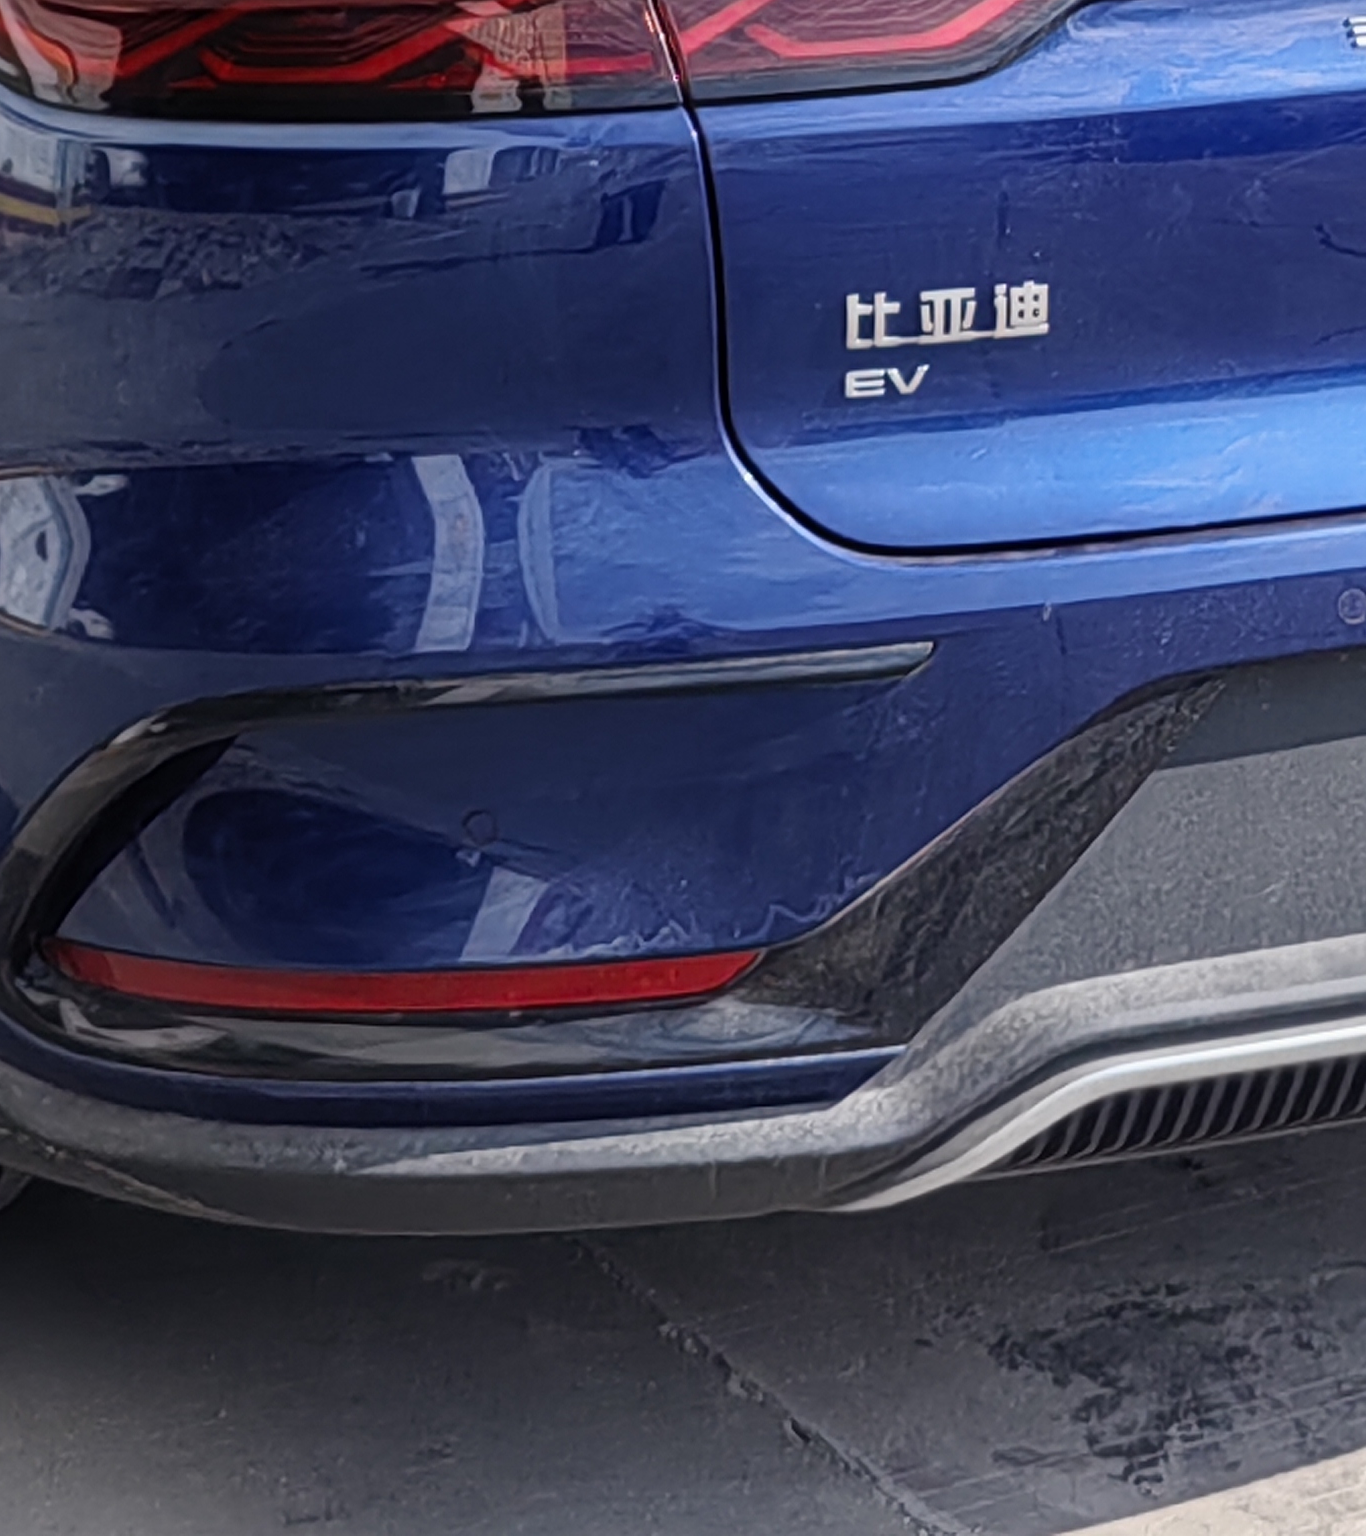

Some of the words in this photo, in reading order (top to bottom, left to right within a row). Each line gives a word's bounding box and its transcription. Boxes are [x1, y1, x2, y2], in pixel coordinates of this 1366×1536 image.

[846, 280, 1050, 349] 比亚迪
[845, 364, 930, 398] EV
